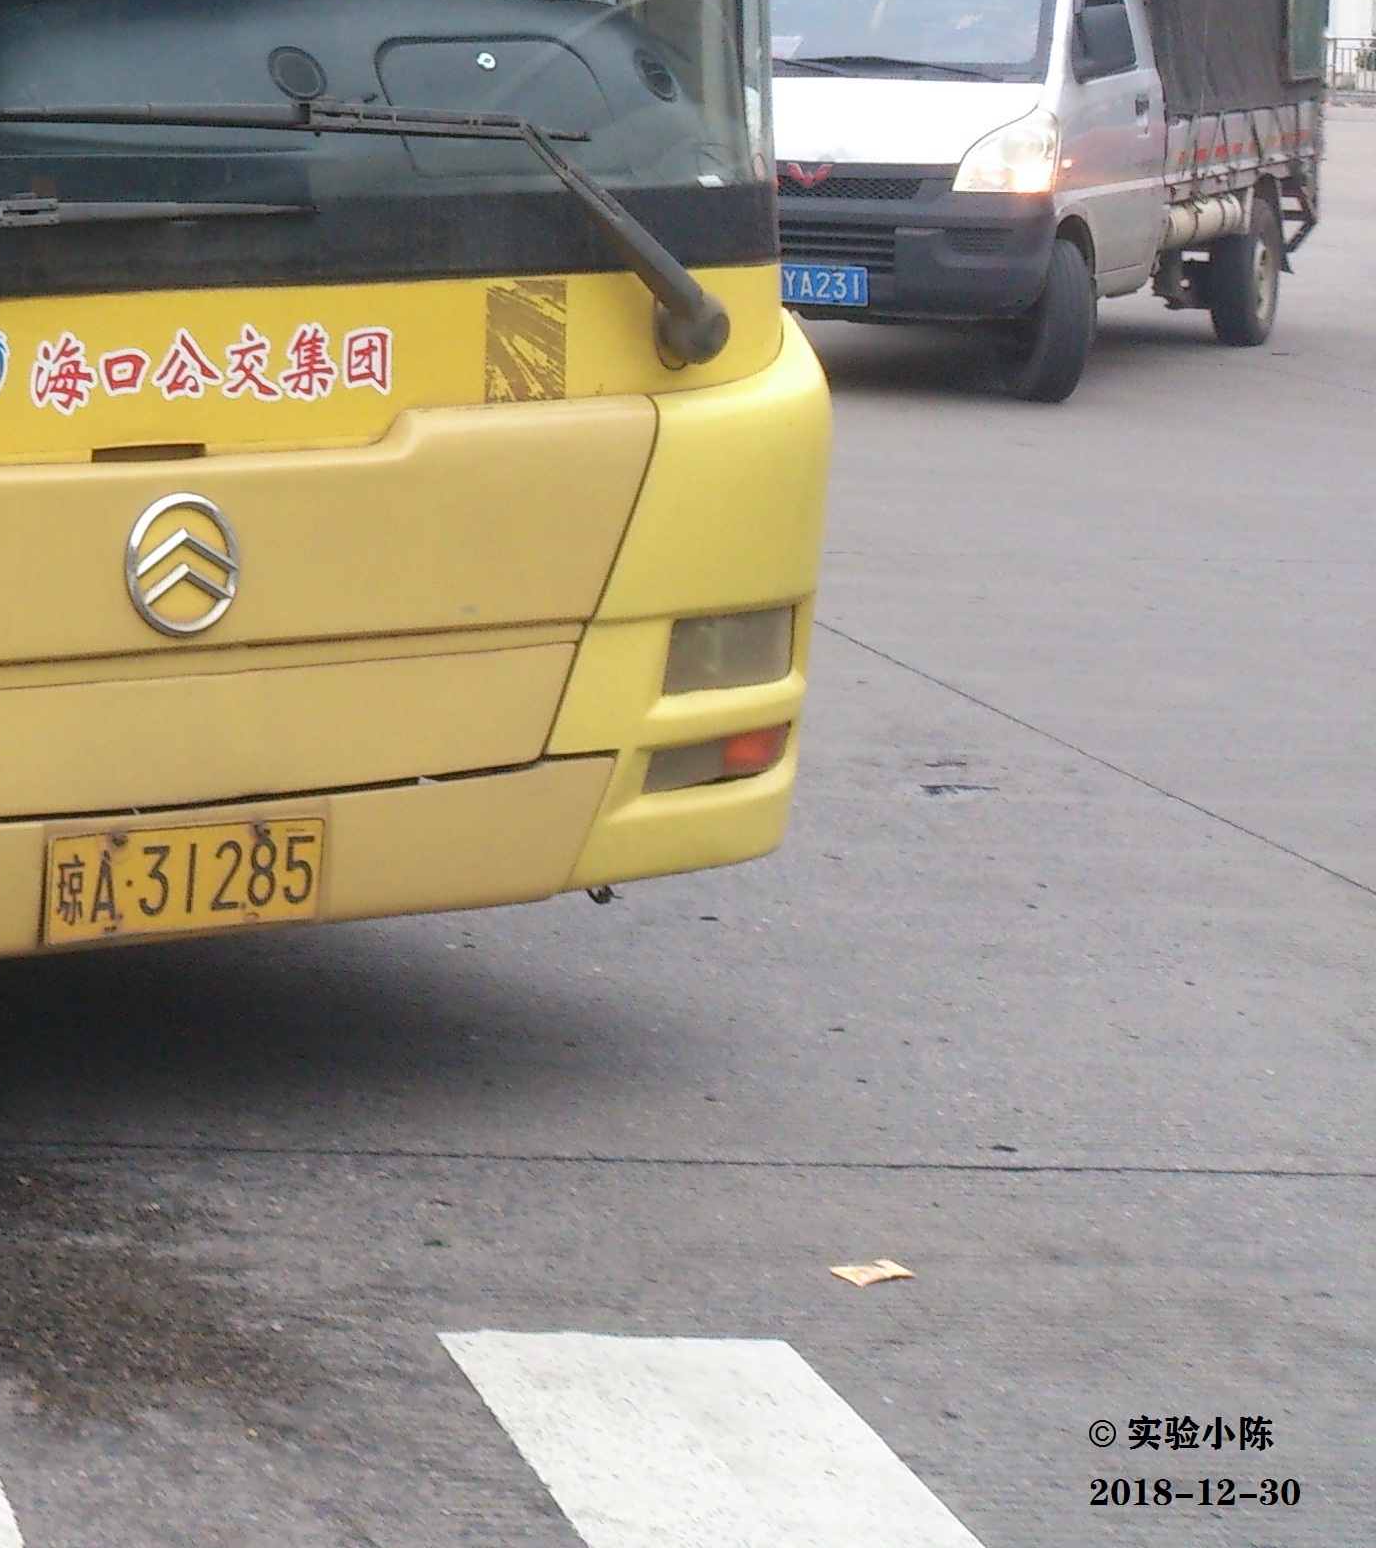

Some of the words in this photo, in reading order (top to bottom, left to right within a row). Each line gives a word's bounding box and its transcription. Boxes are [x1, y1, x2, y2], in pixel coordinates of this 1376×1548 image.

[32, 324, 393, 414] 海口公交集团
